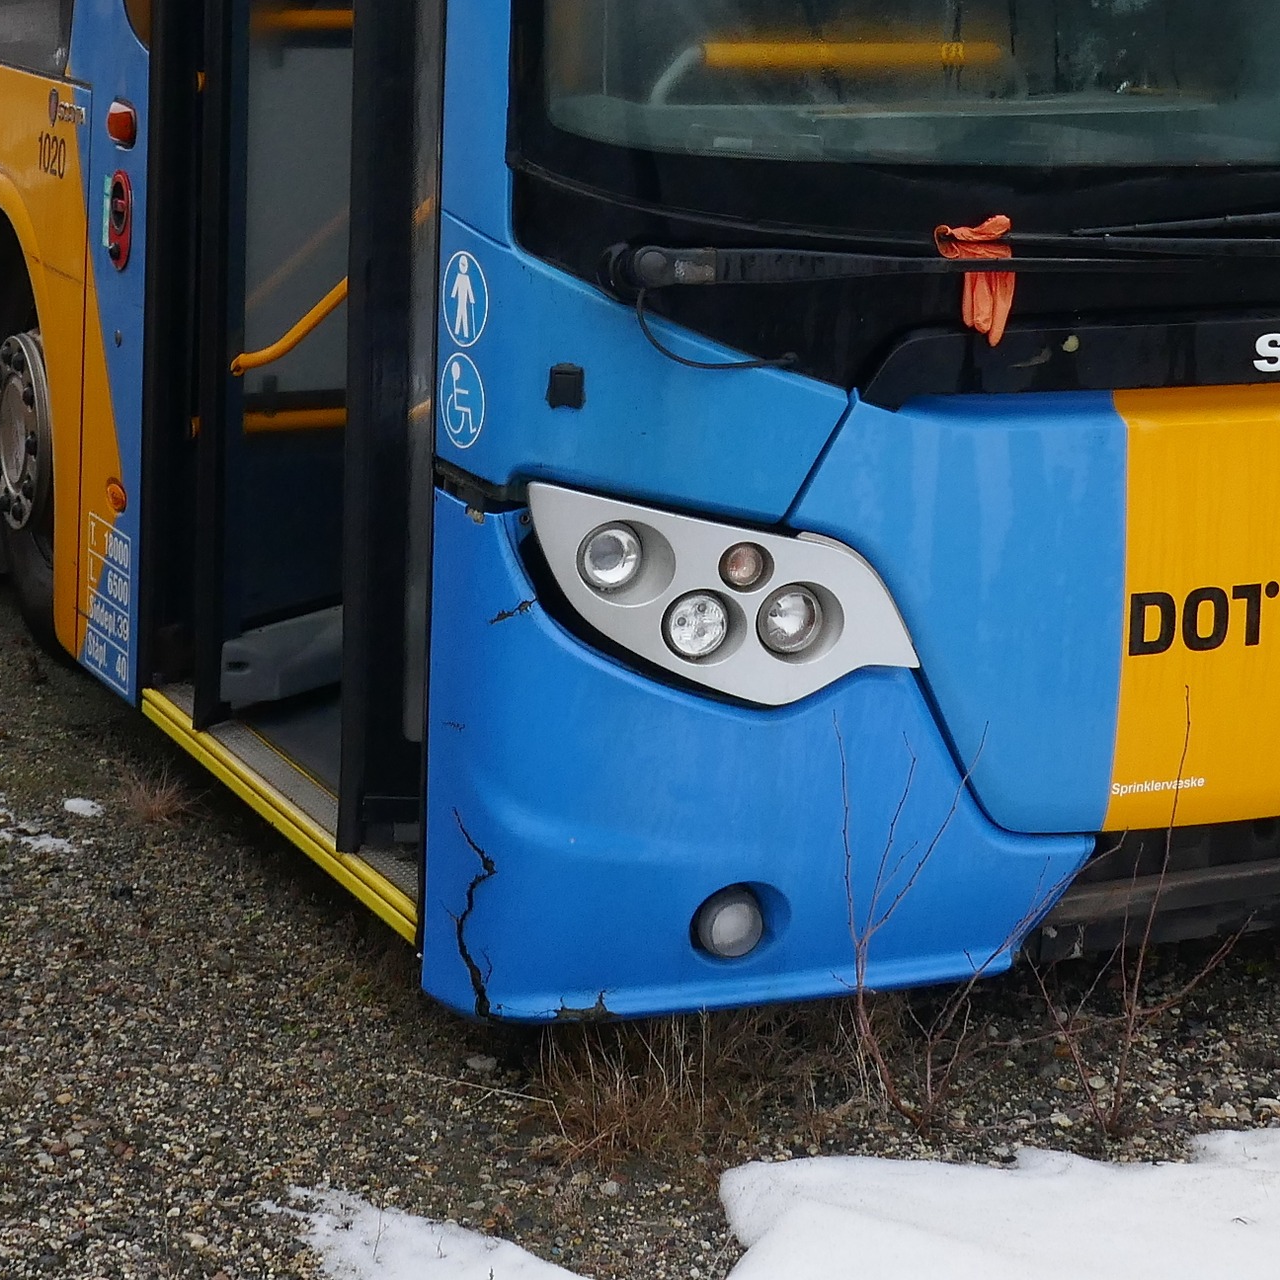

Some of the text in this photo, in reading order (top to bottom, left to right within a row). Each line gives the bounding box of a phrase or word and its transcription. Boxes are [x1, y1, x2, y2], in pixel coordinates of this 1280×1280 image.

[38, 130, 66, 180] 1020
[90, 521, 129, 569] T. 18000
[107, 569, 129, 607] 6500
[1128, 581, 1280, 657] DOT
[115, 653, 127, 682] 40
[1111, 776, 1205, 797] Sprinklervæske
